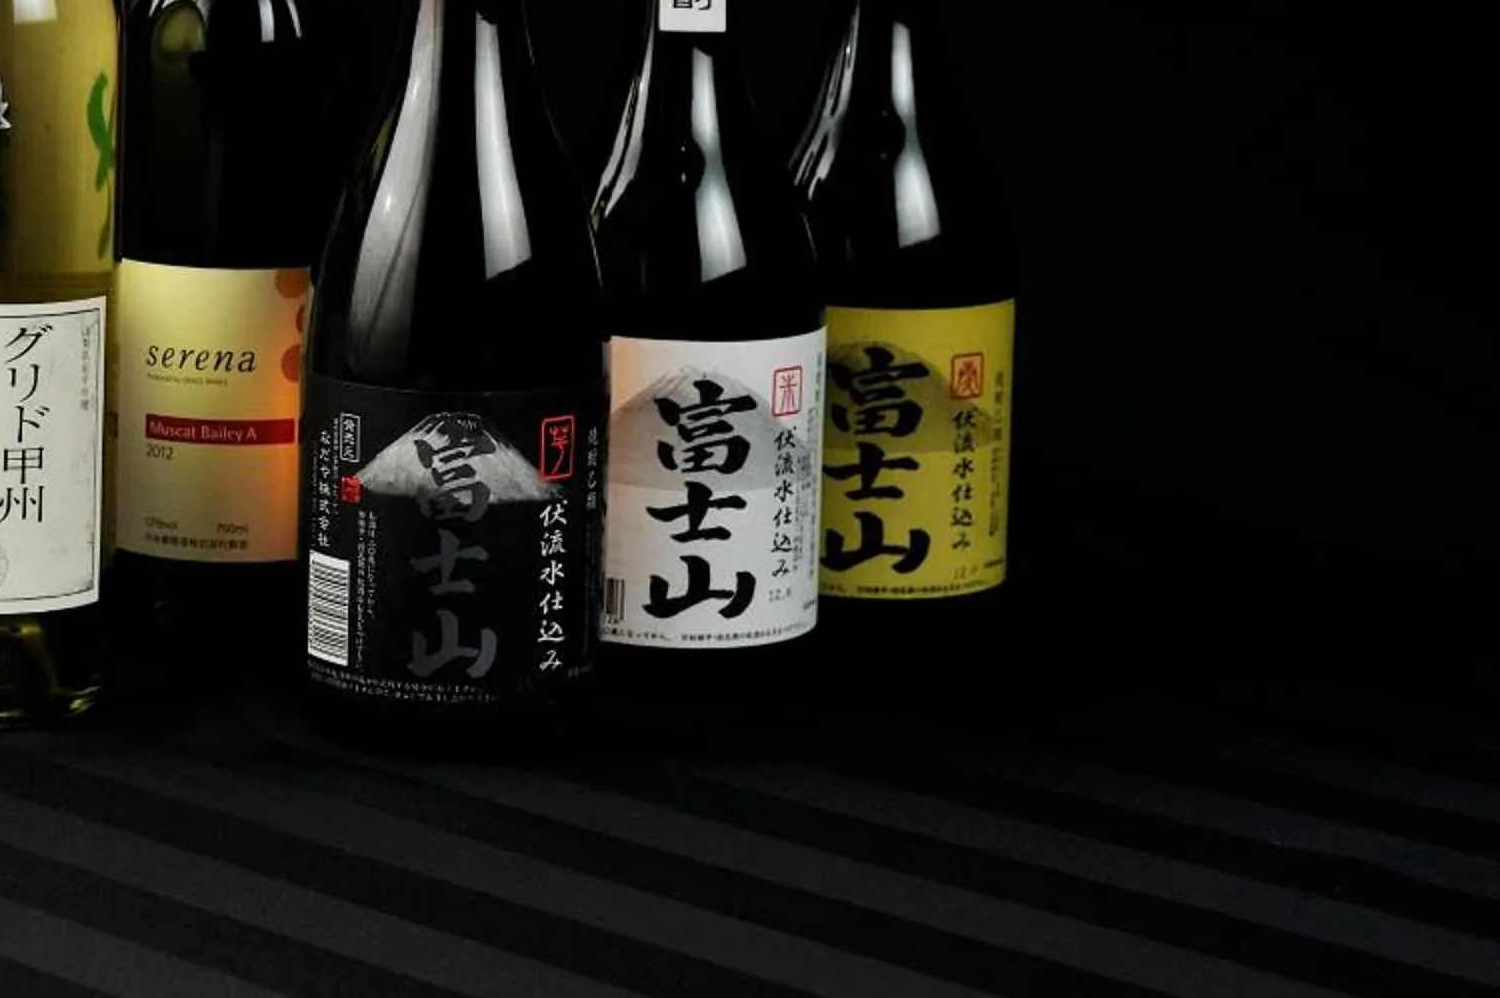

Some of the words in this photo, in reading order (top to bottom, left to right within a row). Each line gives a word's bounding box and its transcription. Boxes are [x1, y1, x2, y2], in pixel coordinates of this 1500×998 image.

[145, 344, 257, 374] serena
[149, 419, 196, 440] Muscat
[201, 424, 243, 444] Bailey
[246, 428, 258, 442] A
[778, 373, 798, 412] 米
[146, 444, 175, 461] 2012
[641, 378, 759, 620] 富士山
[770, 425, 799, 578] 伏流水仕込み
[818, 346, 932, 575] 富士山
[406, 412, 498, 680] 富士山
[537, 498, 568, 672] 伏流水仕込み
